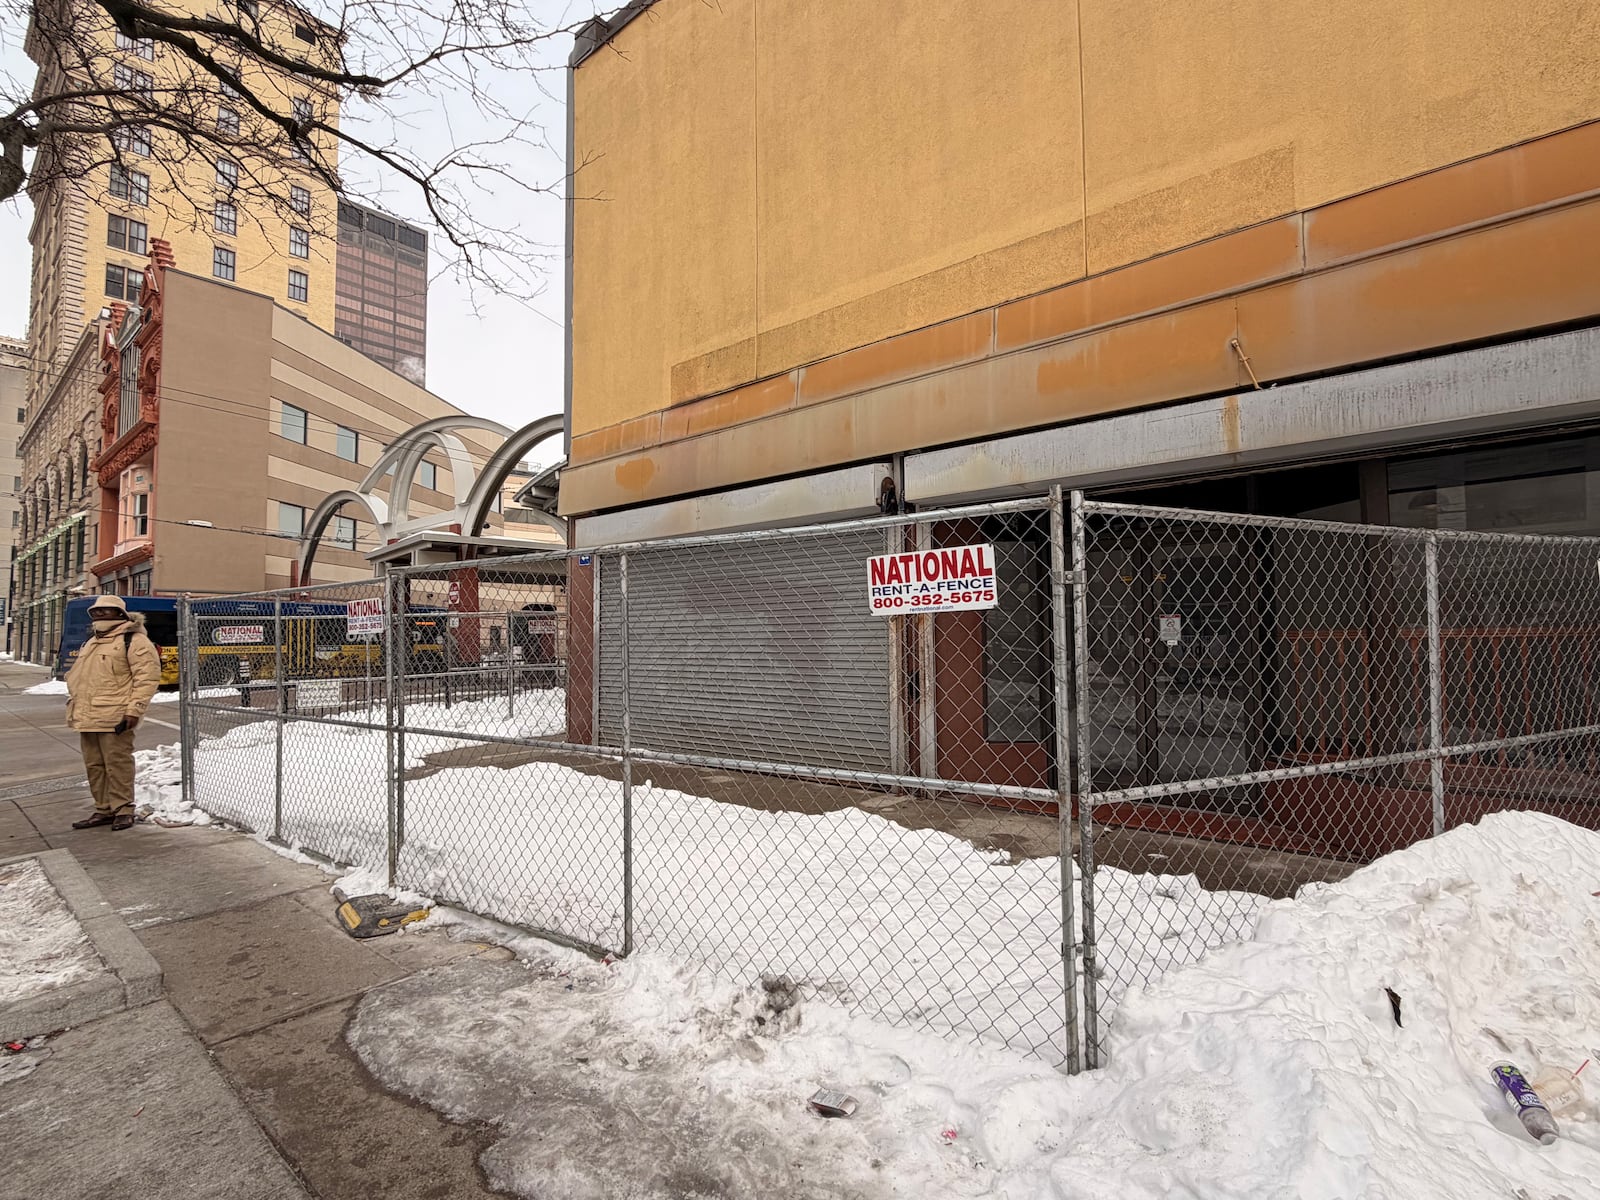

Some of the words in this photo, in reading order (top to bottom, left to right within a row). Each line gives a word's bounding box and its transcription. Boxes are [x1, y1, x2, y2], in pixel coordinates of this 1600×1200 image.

[870, 547, 993, 586] NATIONAL
[872, 577, 993, 597] RENT-A-FENCE
[348, 599, 382, 618] NATIONAL
[873, 590, 994, 609] 800-352-5675
[220, 626, 263, 635] NATIONAL
